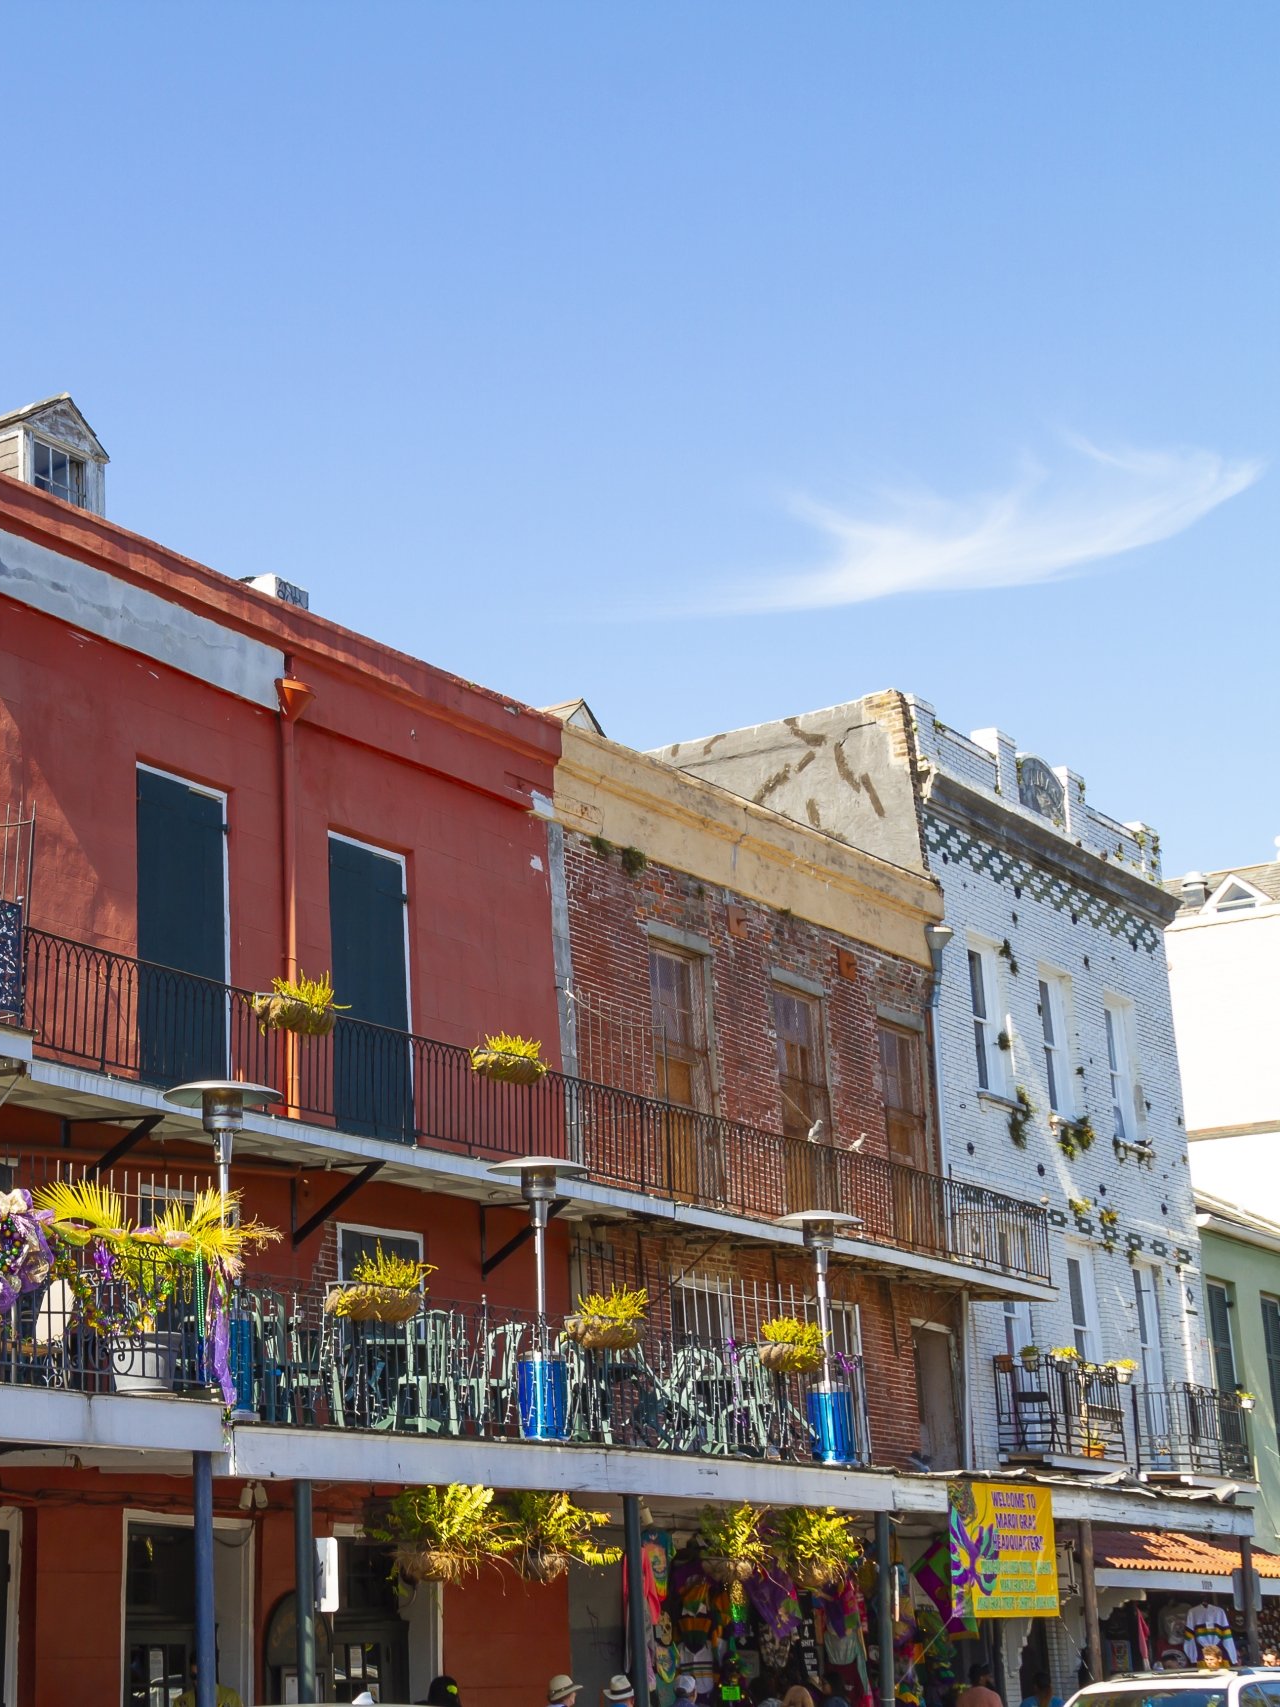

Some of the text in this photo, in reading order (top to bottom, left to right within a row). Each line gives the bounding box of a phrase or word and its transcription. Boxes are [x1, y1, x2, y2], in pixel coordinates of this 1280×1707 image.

[991, 1491, 1036, 1509] WELCOME TO
[995, 1513, 1018, 1529] MARDI
